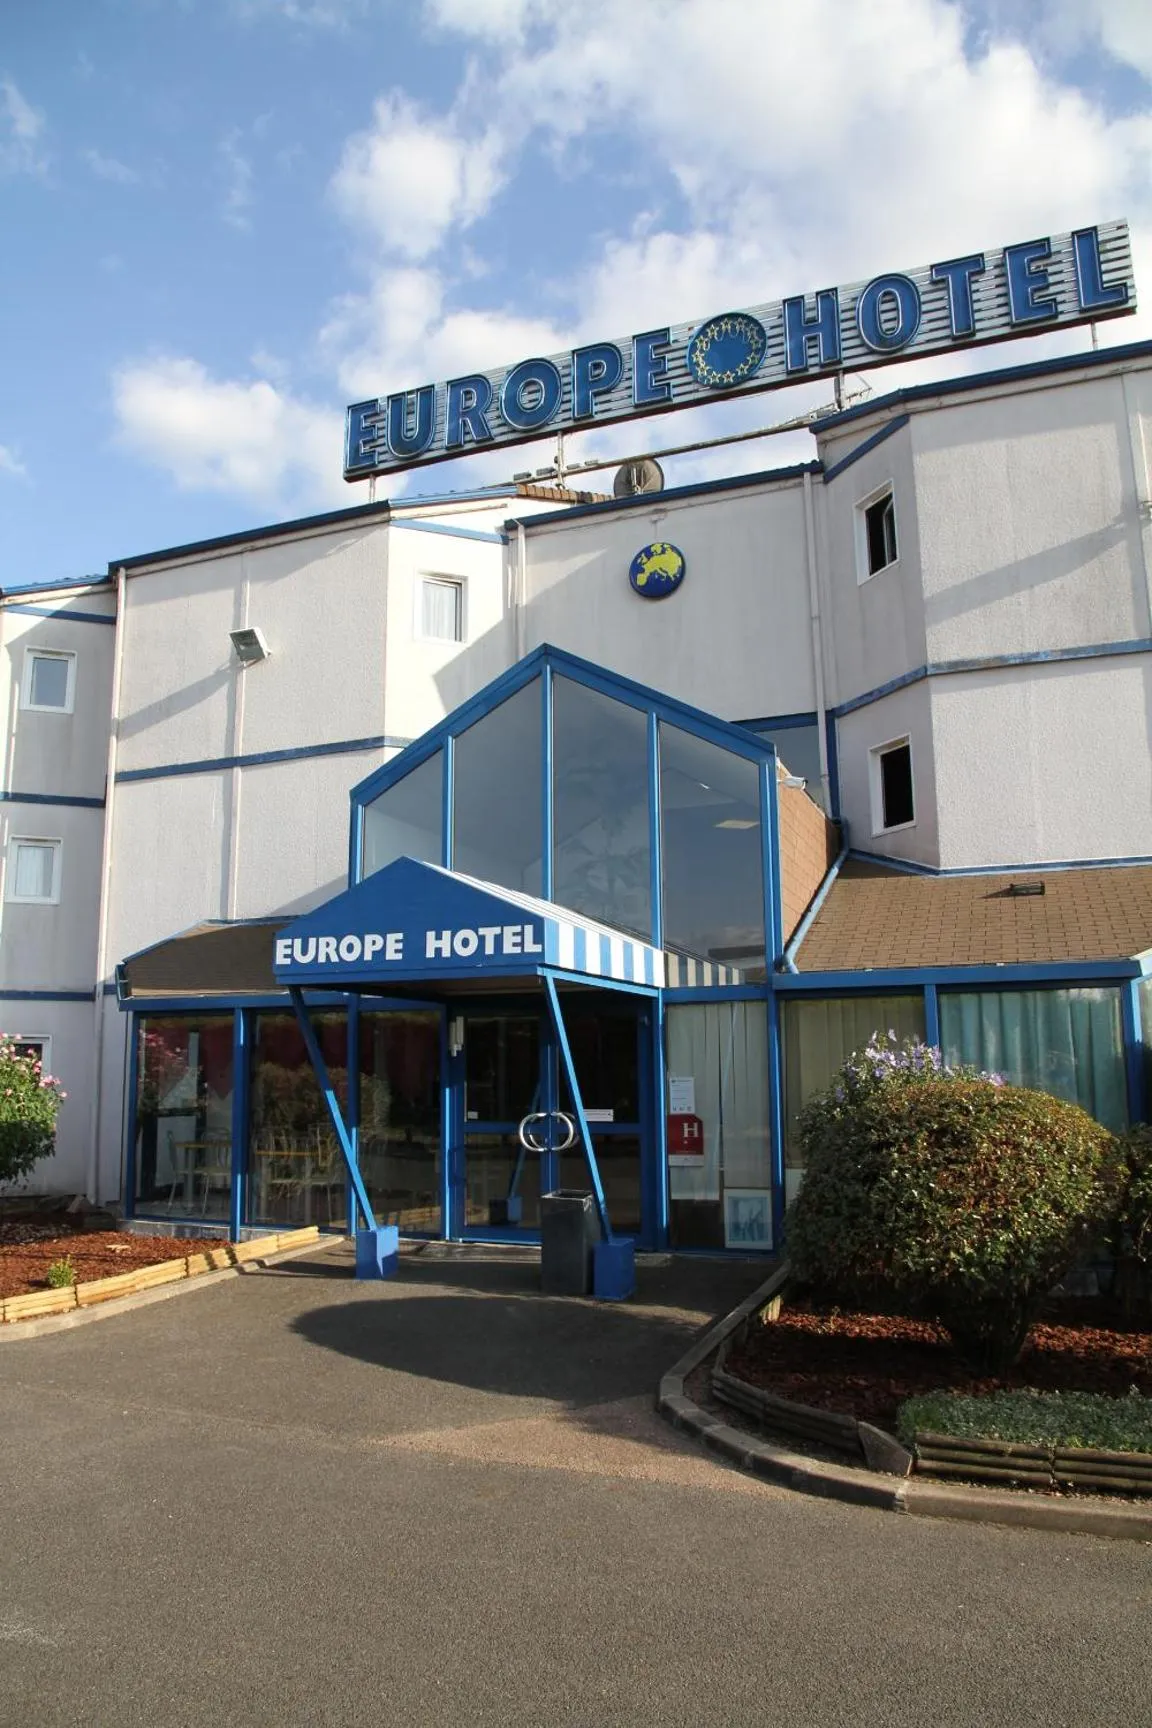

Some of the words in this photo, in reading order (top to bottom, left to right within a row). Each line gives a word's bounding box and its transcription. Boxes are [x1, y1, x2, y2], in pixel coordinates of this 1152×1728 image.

[345, 327, 673, 469] EUROPE
[782, 226, 1128, 375] HOTEL
[276, 933, 403, 965] EUROPE
[426, 925, 542, 958] HOTEL
[682, 1122, 699, 1138] H
